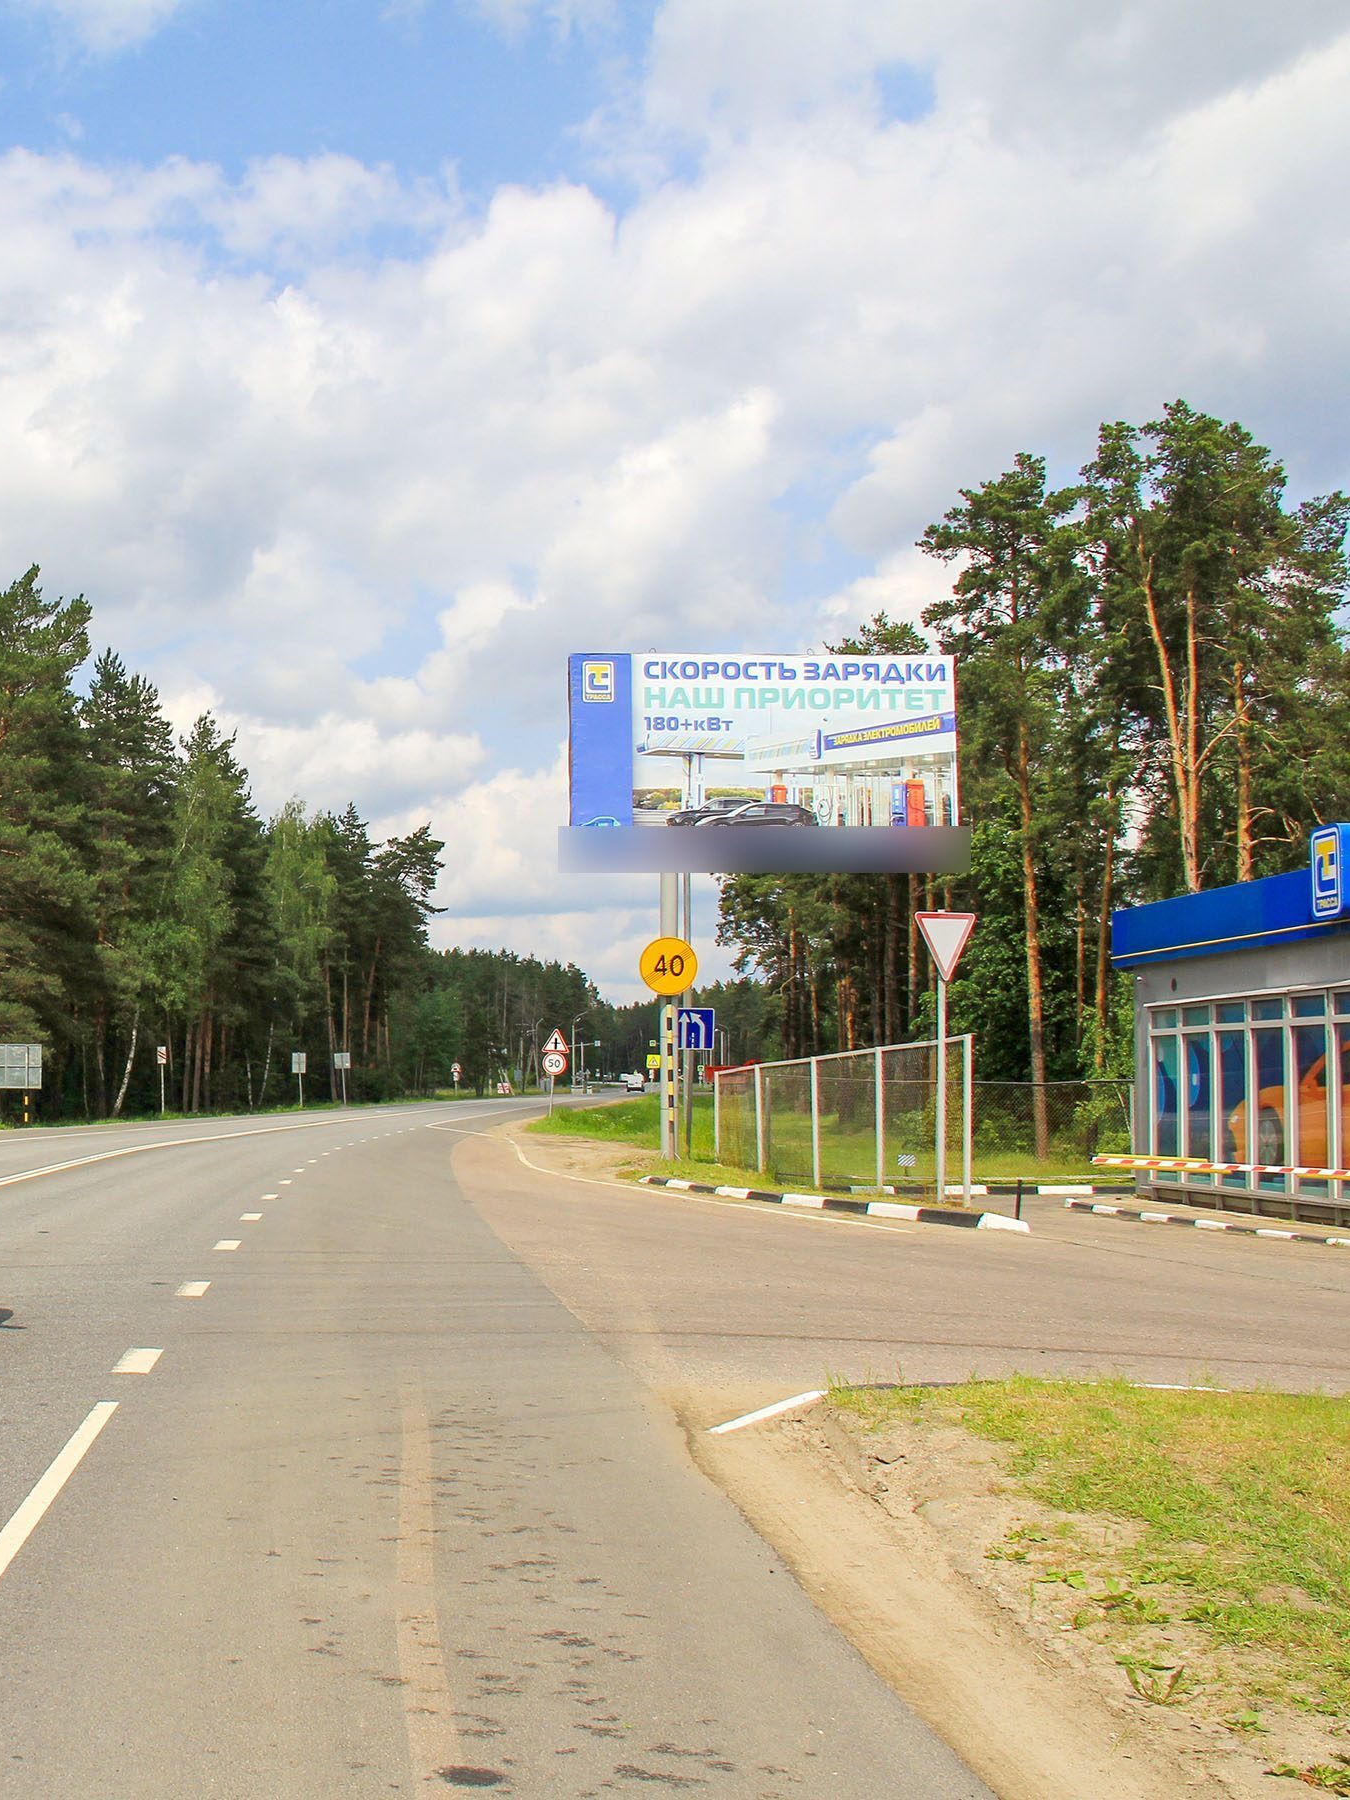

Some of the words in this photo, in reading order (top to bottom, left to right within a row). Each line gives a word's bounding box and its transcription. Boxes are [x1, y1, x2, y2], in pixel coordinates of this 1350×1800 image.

[643, 661, 797, 681] СКОРОСТЬ
[803, 662, 947, 684] ЗАРЯДКИ
[643, 686, 724, 709] НАШ
[734, 687, 947, 711] ПРИОРИТЕТ
[643, 716, 734, 732] 180+кВт
[654, 954, 684, 976] 40
[548, 1058, 561, 1068] 50
